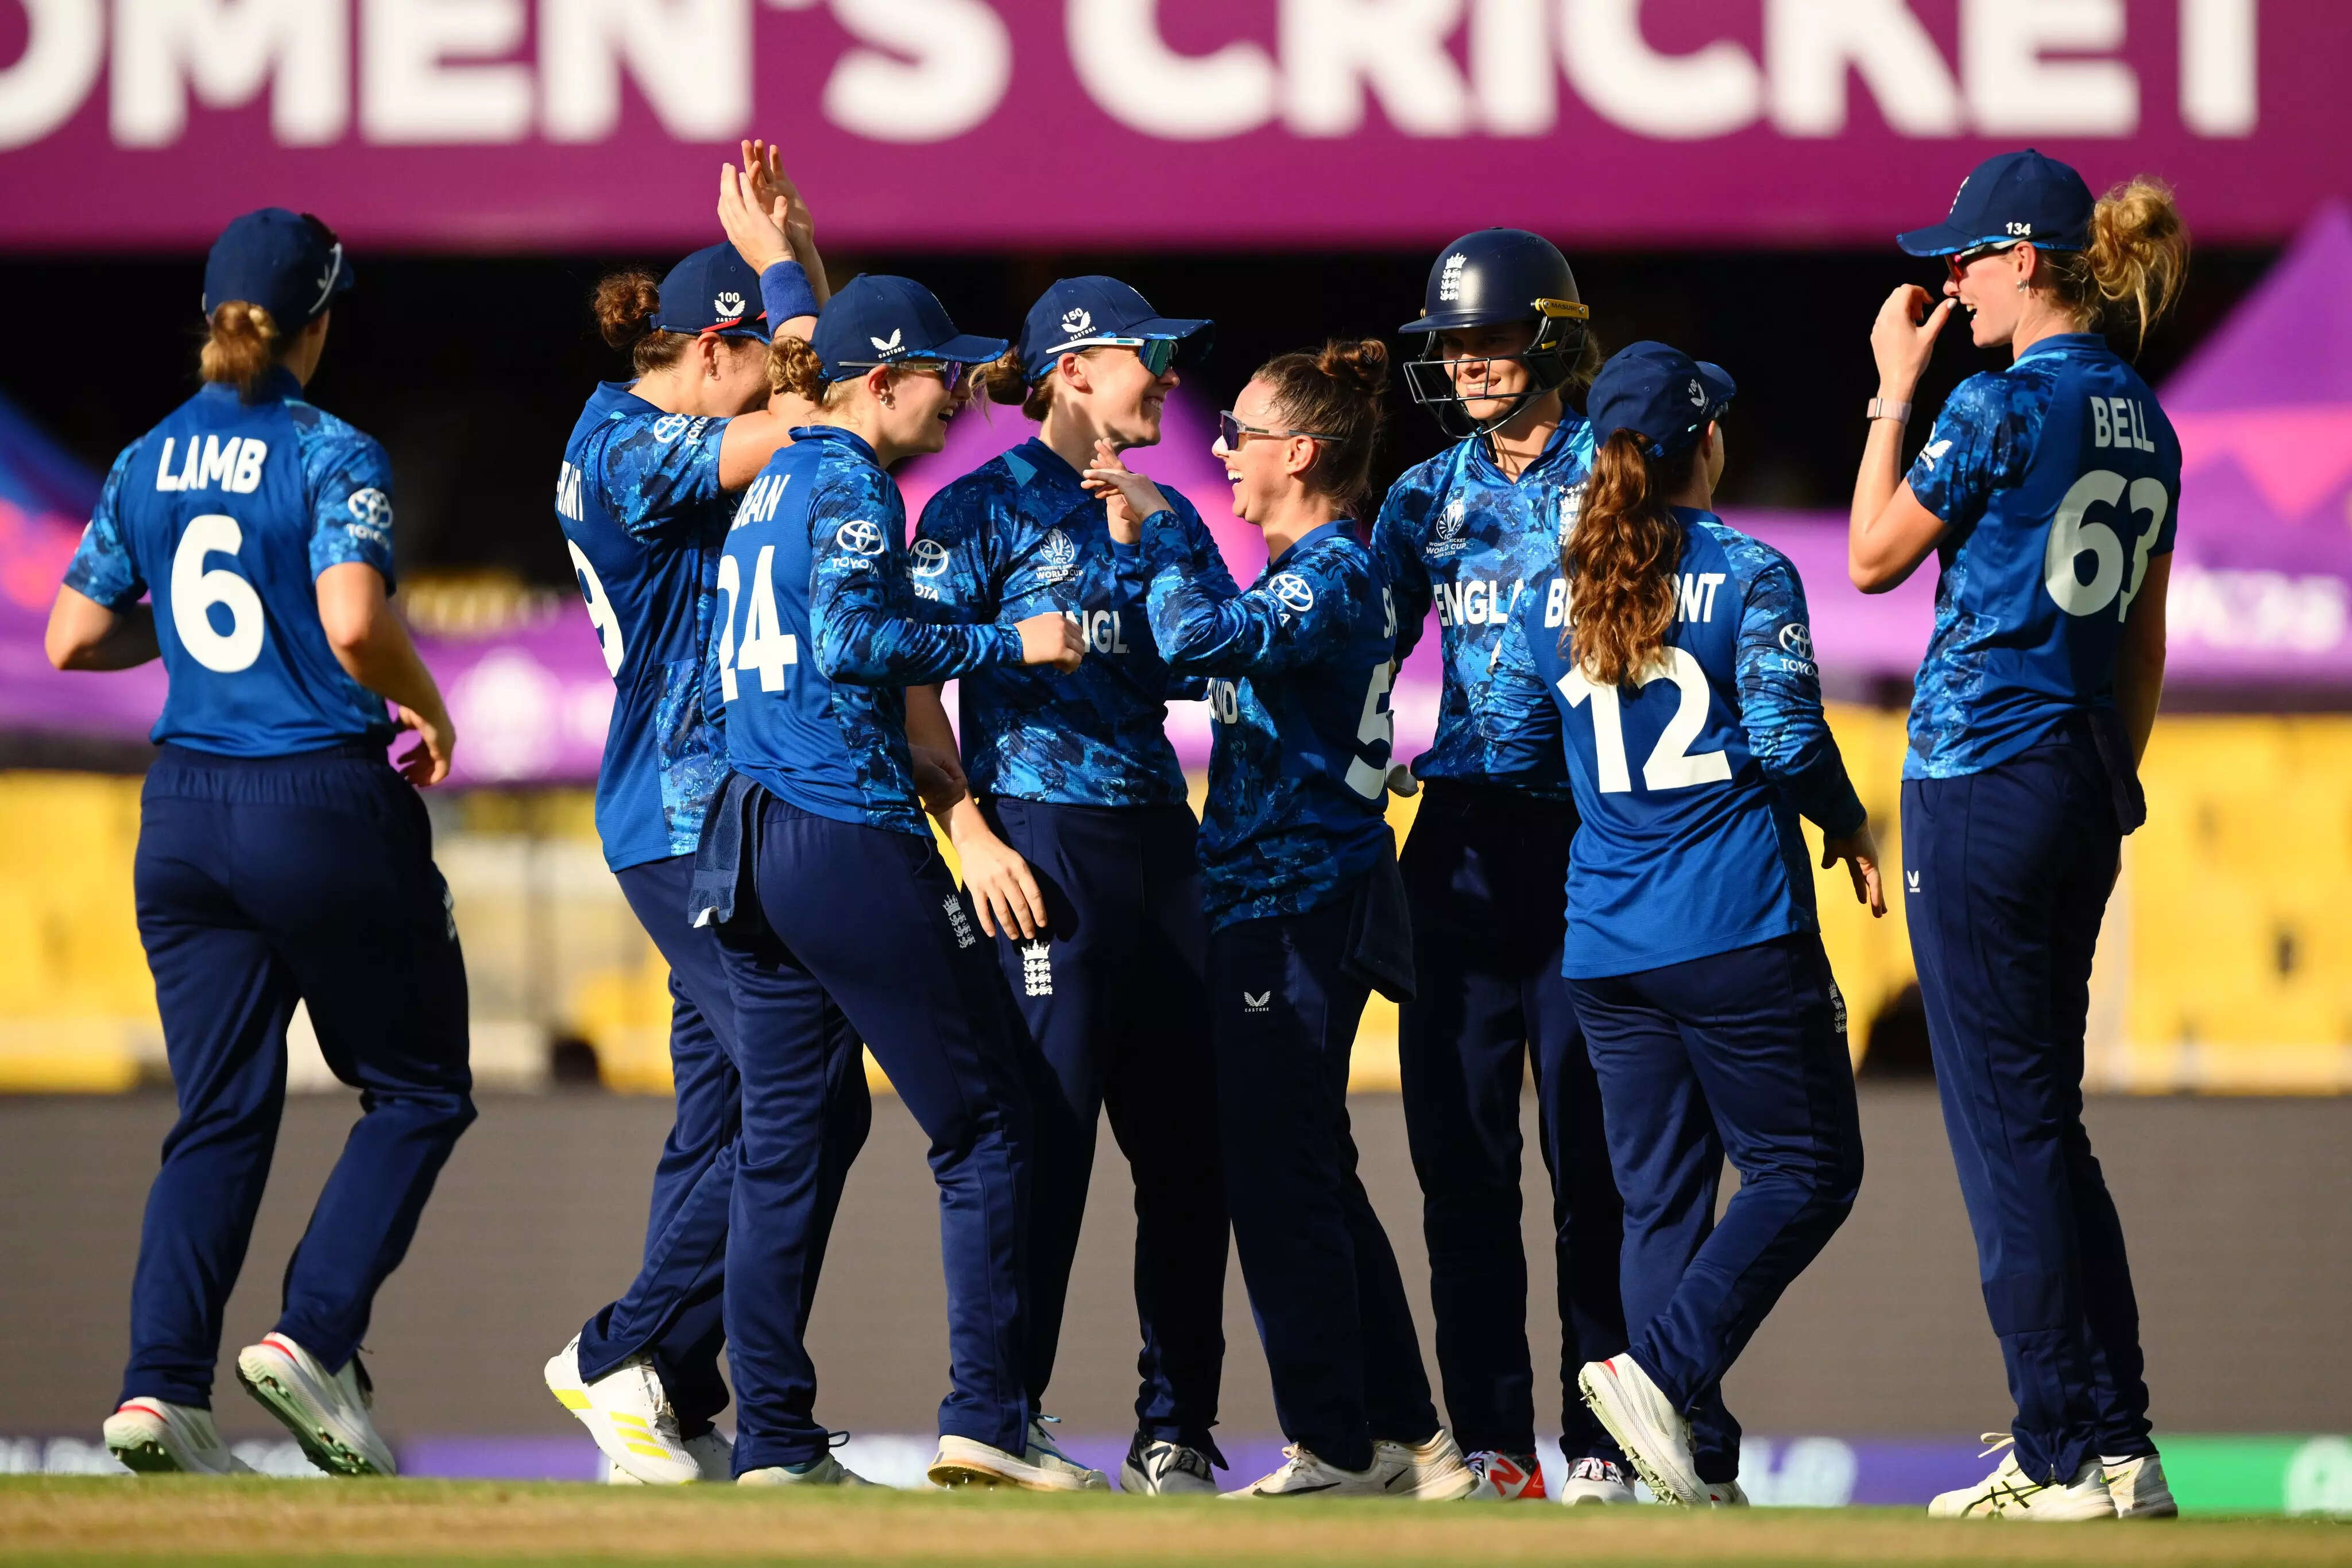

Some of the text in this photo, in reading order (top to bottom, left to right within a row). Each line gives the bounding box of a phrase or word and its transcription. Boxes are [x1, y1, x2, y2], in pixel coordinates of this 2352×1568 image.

[2006, 222, 2032, 236] 134
[718, 292, 740, 303] 100
[1551, 303, 1577, 311] MASURI
[1062, 307, 1084, 323] 150
[878, 346, 906, 359] CASTORE
[2090, 396, 2155, 454] BELL
[156, 435, 268, 494] LAMB
[2045, 469, 2168, 624] 63
[831, 557, 879, 578] TOYOTA
[1035, 570, 1069, 579] WORLD
[171, 514, 264, 673] 6
[717, 545, 798, 703] 24
[1780, 658, 1818, 679] TOYO
[1556, 645, 1732, 793] 12
